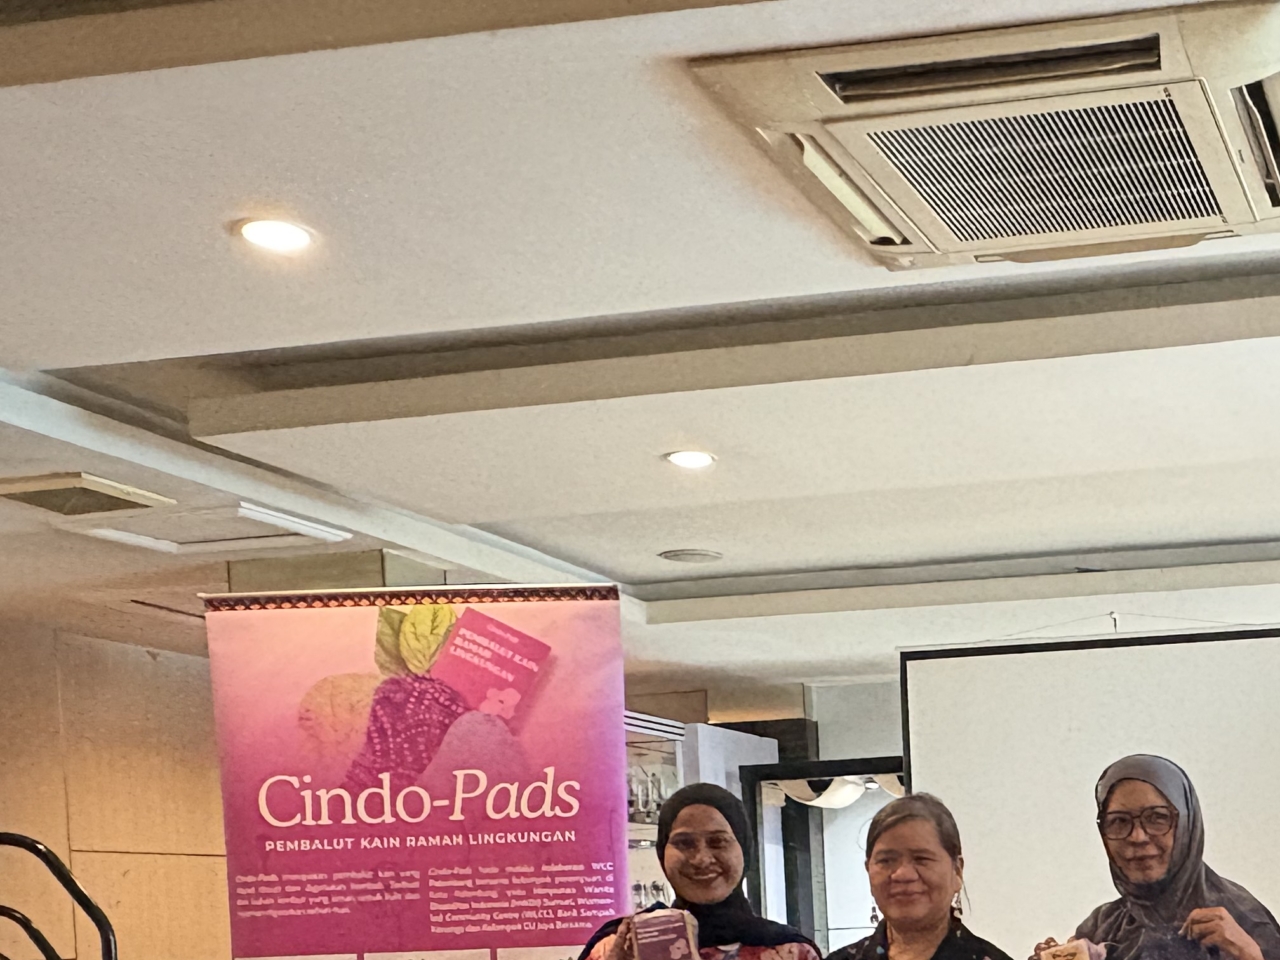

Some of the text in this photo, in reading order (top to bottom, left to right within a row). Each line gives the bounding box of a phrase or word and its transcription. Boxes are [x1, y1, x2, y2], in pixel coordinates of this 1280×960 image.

[258, 766, 581, 828] Cindo-Pads
[265, 830, 576, 852] PEMBALUT KAIN RAMAH LINGKUNGAN
